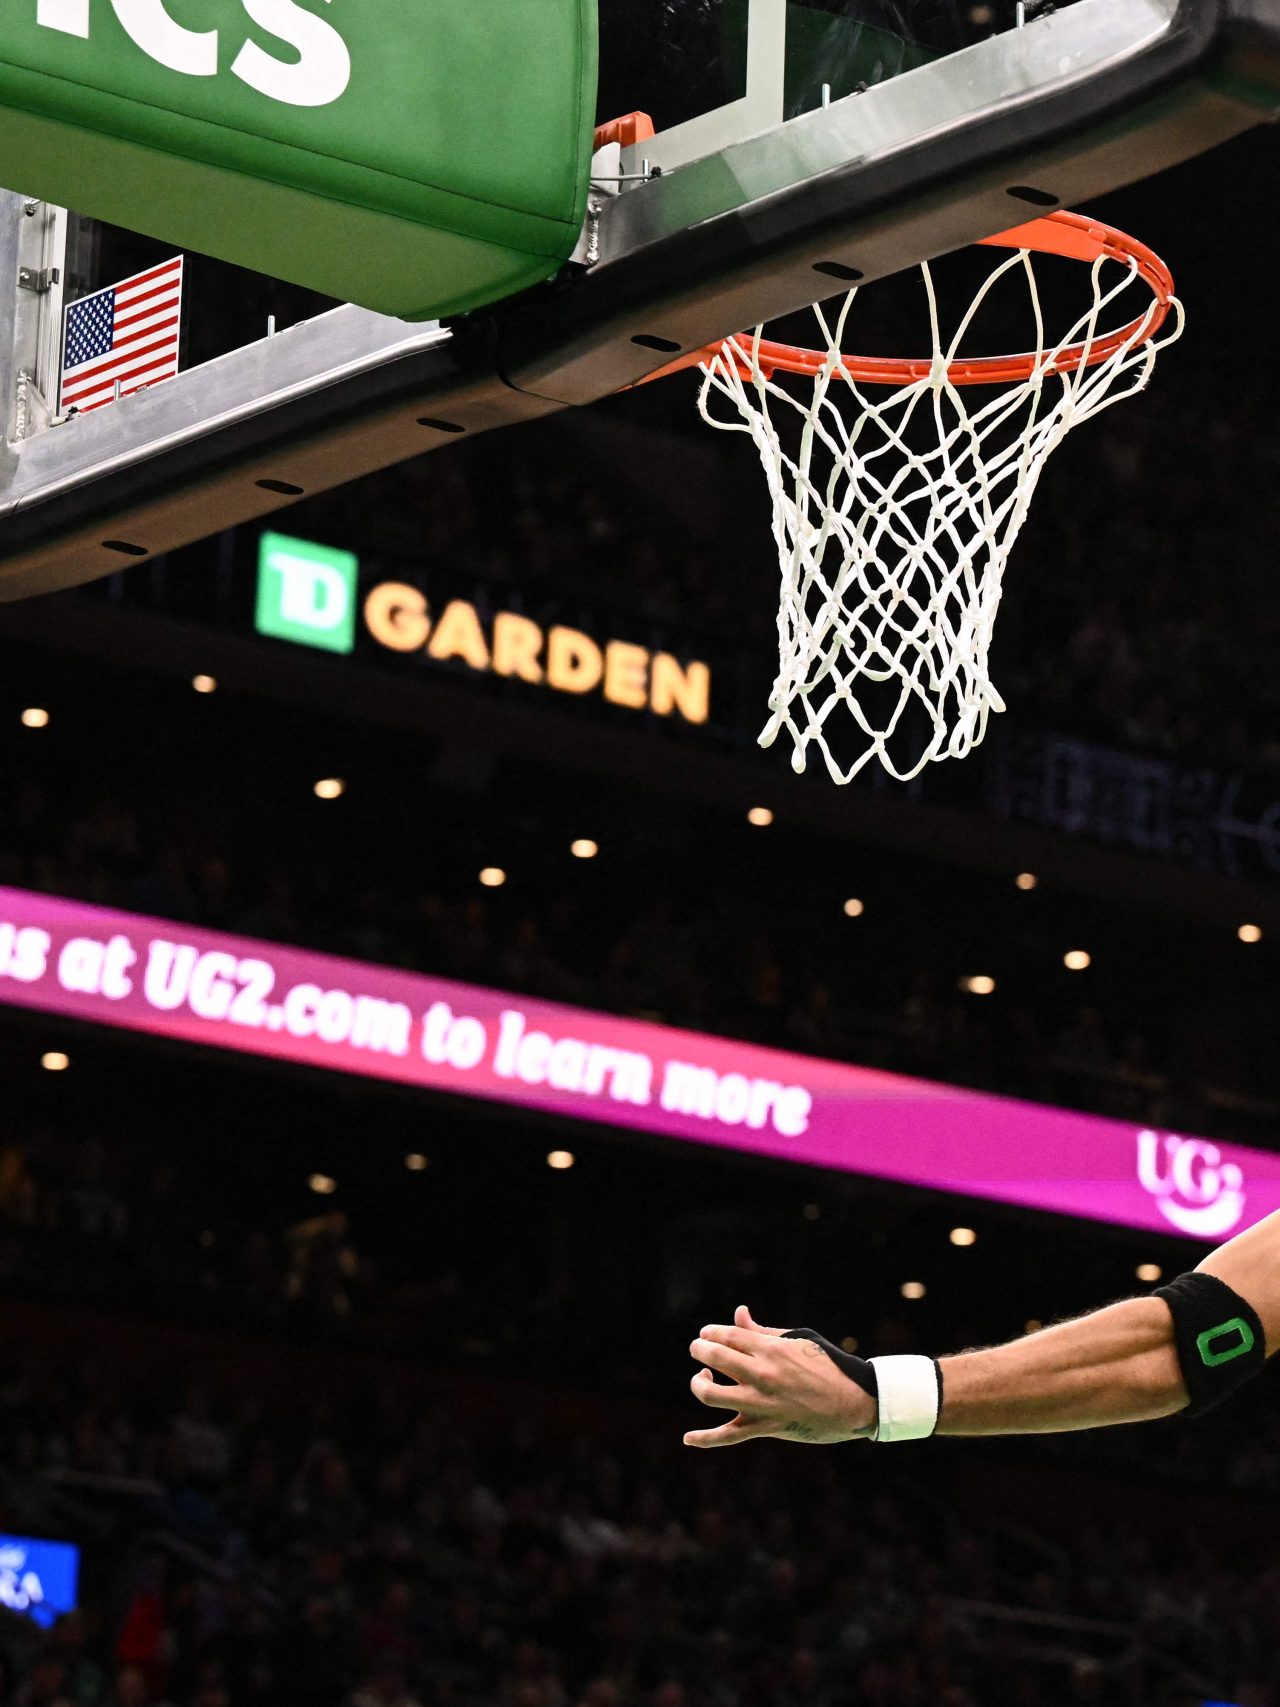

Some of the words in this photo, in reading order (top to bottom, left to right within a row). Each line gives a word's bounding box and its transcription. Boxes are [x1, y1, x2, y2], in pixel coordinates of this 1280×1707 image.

[266, 550, 349, 631] TD
[363, 581, 711, 725] GARDEN
[57, 935, 137, 1000] at
[144, 939, 413, 1057] UG2.com
[421, 1001, 487, 1070] to
[492, 1010, 654, 1105] learn
[660, 1060, 812, 1136] more
